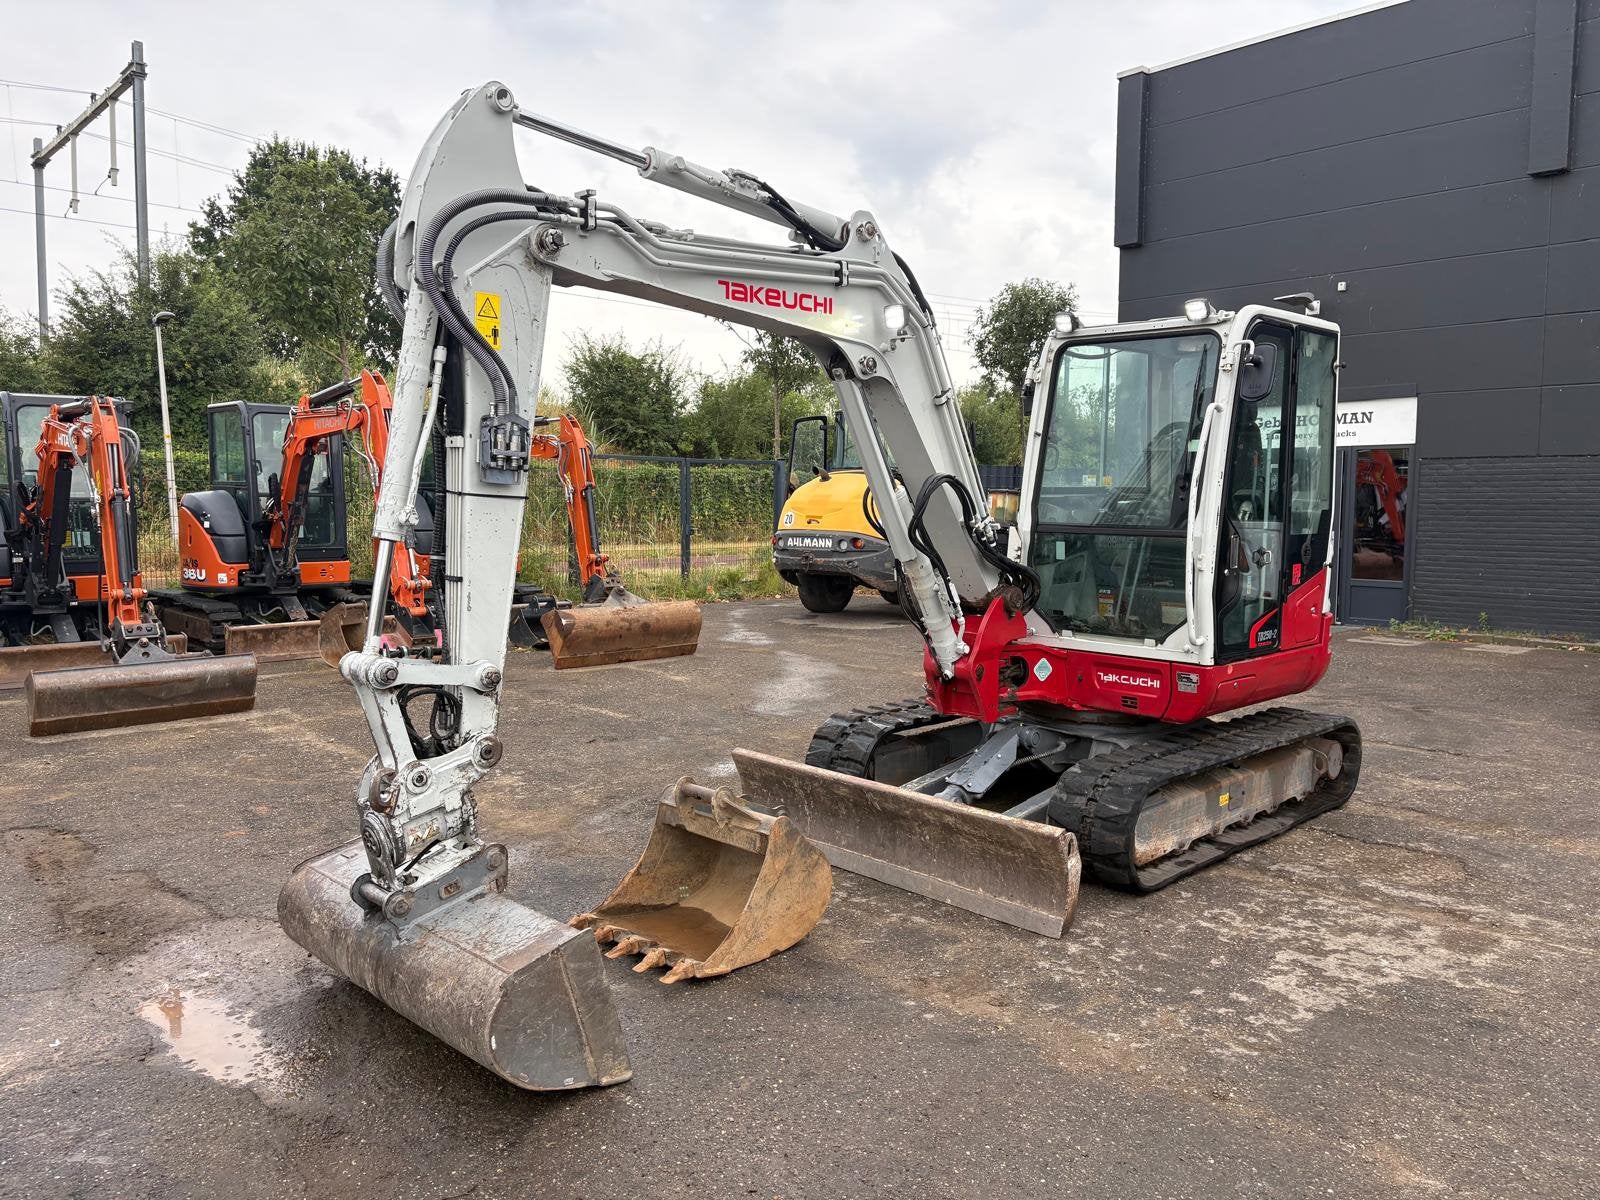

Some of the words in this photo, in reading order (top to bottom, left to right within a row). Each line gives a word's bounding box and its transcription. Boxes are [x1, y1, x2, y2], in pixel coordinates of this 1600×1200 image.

[717, 279, 833, 315] TAKEUCHI
[784, 514, 793, 524] 20
[787, 537, 833, 548] AHLMANN
